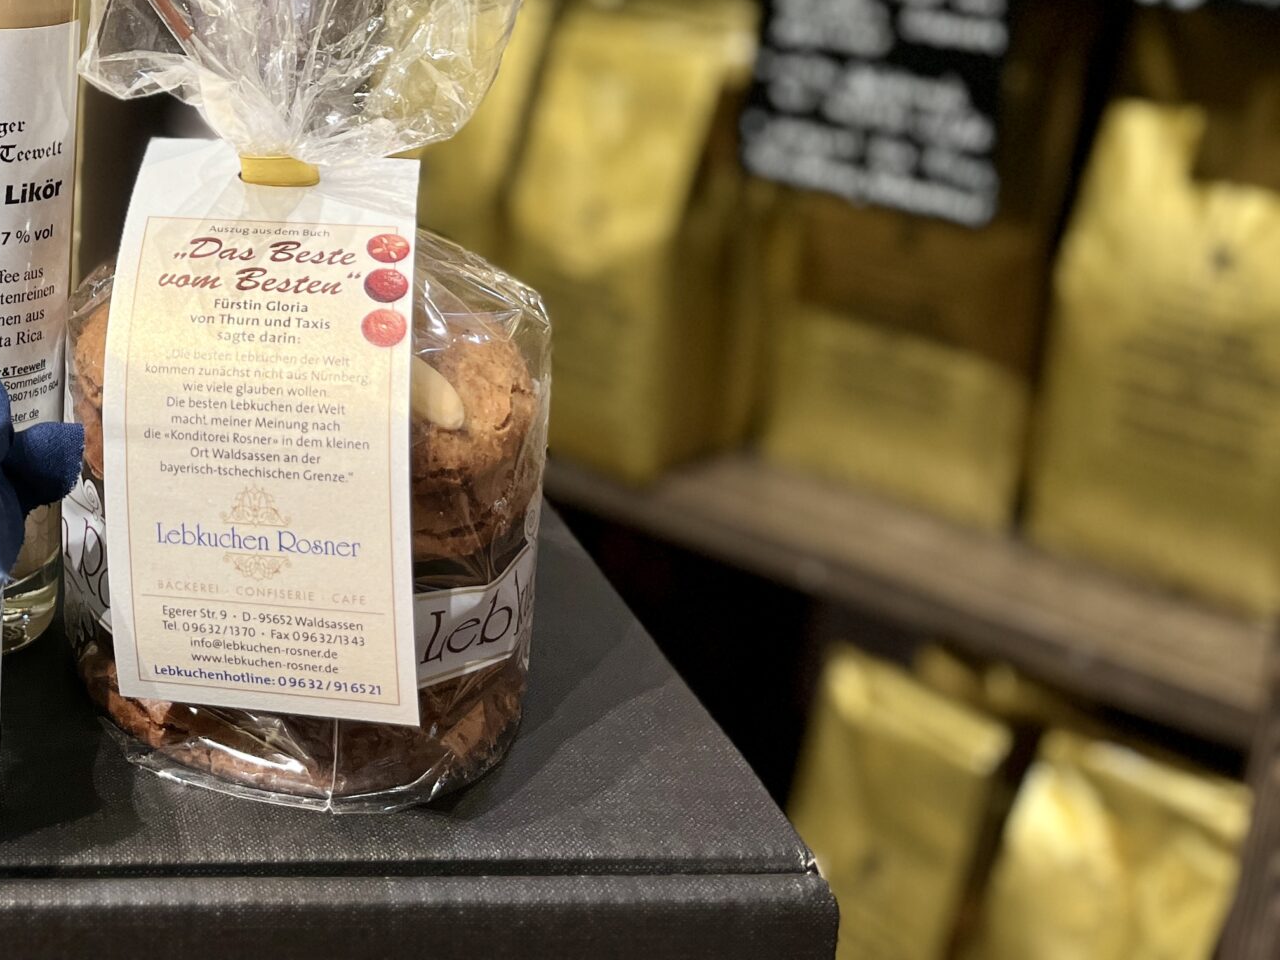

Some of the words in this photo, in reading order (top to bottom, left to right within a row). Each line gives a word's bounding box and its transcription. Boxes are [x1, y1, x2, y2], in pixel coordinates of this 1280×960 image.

[0, 141, 63, 164] Teewelt
[5, 179, 62, 205] Likör
[16, 230, 31, 244] %
[35, 224, 54, 241] vol
[208, 224, 250, 236] Auszug
[252, 228, 272, 236] aus
[274, 228, 300, 237] dem
[302, 228, 331, 238] Buch
[269, 240, 357, 266] Beste
[24, 267, 44, 281] aus
[158, 272, 222, 290] vom
[214, 297, 262, 311] Fürstin
[266, 300, 309, 313] Gloria
[25, 308, 45, 324] aus
[190, 315, 215, 325] von
[219, 313, 260, 326] Thurn
[264, 316, 291, 328] und
[295, 317, 331, 330] Taxis
[217, 329, 256, 345] sagte
[259, 330, 301, 345] darin:
[300, 353, 320, 366] der
[322, 355, 350, 368] Welt
[145, 362, 195, 376] kommen
[198, 366, 251, 378] zunächst
[254, 367, 285, 380] nicht
[286, 370, 308, 381] aus
[182, 381, 204, 392] wie
[206, 381, 233, 393] viele
[236, 383, 284, 397] glauben
[166, 396, 186, 408] Die
[188, 397, 227, 410] besten
[230, 399, 293, 413] Lebkuchen
[295, 402, 316, 414] der
[318, 403, 346, 415] Welt
[171, 413, 208, 426] macht
[210, 415, 252, 427] meiner
[254, 417, 309, 434] Meinung
[311, 420, 341, 432] nach
[144, 427, 161, 440] die
[281, 437, 293, 446] in
[295, 436, 323, 448] dem
[326, 437, 370, 451] kleinen
[190, 446, 210, 458] Ort
[212, 447, 280, 463] Waldsassen
[283, 454, 298, 464] an
[301, 452, 322, 464] der
[160, 460, 300, 480] bayerisch-tschechischen
[156, 521, 270, 552] Lebkuchen
[276, 530, 361, 558] Rosner
[235, 586, 315, 602] CONFISERIE
[162, 604, 198, 619] Egerer
[200, 608, 218, 620] Str.
[220, 609, 228, 620] 9
[295, 616, 364, 632] Waldsassen
[270, 628, 290, 641] Fax
[190, 636, 339, 660] info@lebkuchen-rosner.de
[190, 652, 340, 674] www.lebkuchen-rosner.de
[154, 664, 276, 686] Lebkuchenhotline:
